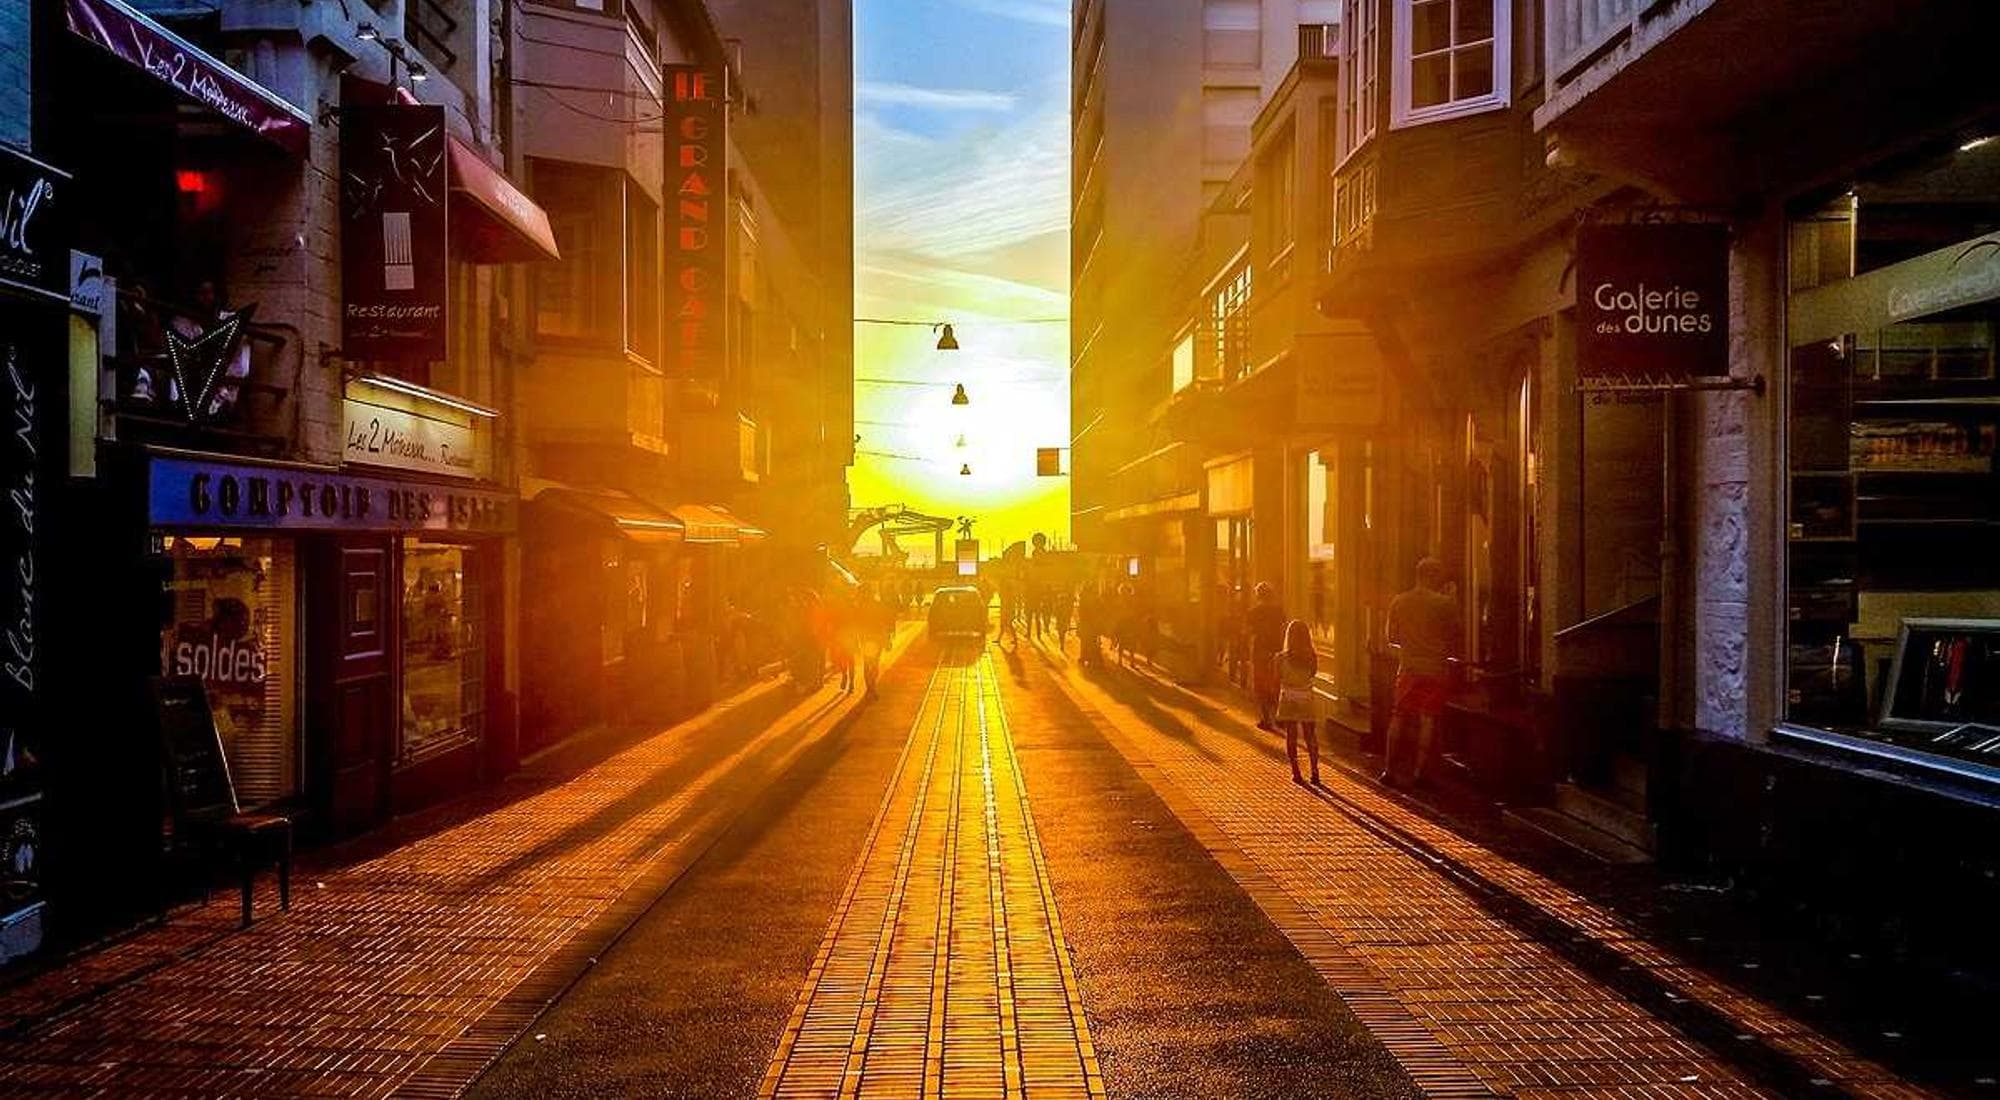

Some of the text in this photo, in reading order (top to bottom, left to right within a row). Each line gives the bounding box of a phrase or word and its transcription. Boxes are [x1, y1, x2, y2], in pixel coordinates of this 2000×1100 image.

[171, 52, 188, 91] 2
[678, 115, 710, 251] GRAND
[346, 303, 441, 319] Restaurant
[1594, 282, 1701, 311] Galerie
[1596, 311, 1713, 333] des dunes
[368, 418, 380, 452] 2
[10, 469, 35, 534] du
[190, 472, 371, 519] COMPTOIR
[388, 488, 431, 521] DES
[5, 549, 34, 692] Blanc
[175, 632, 266, 684] soldes
